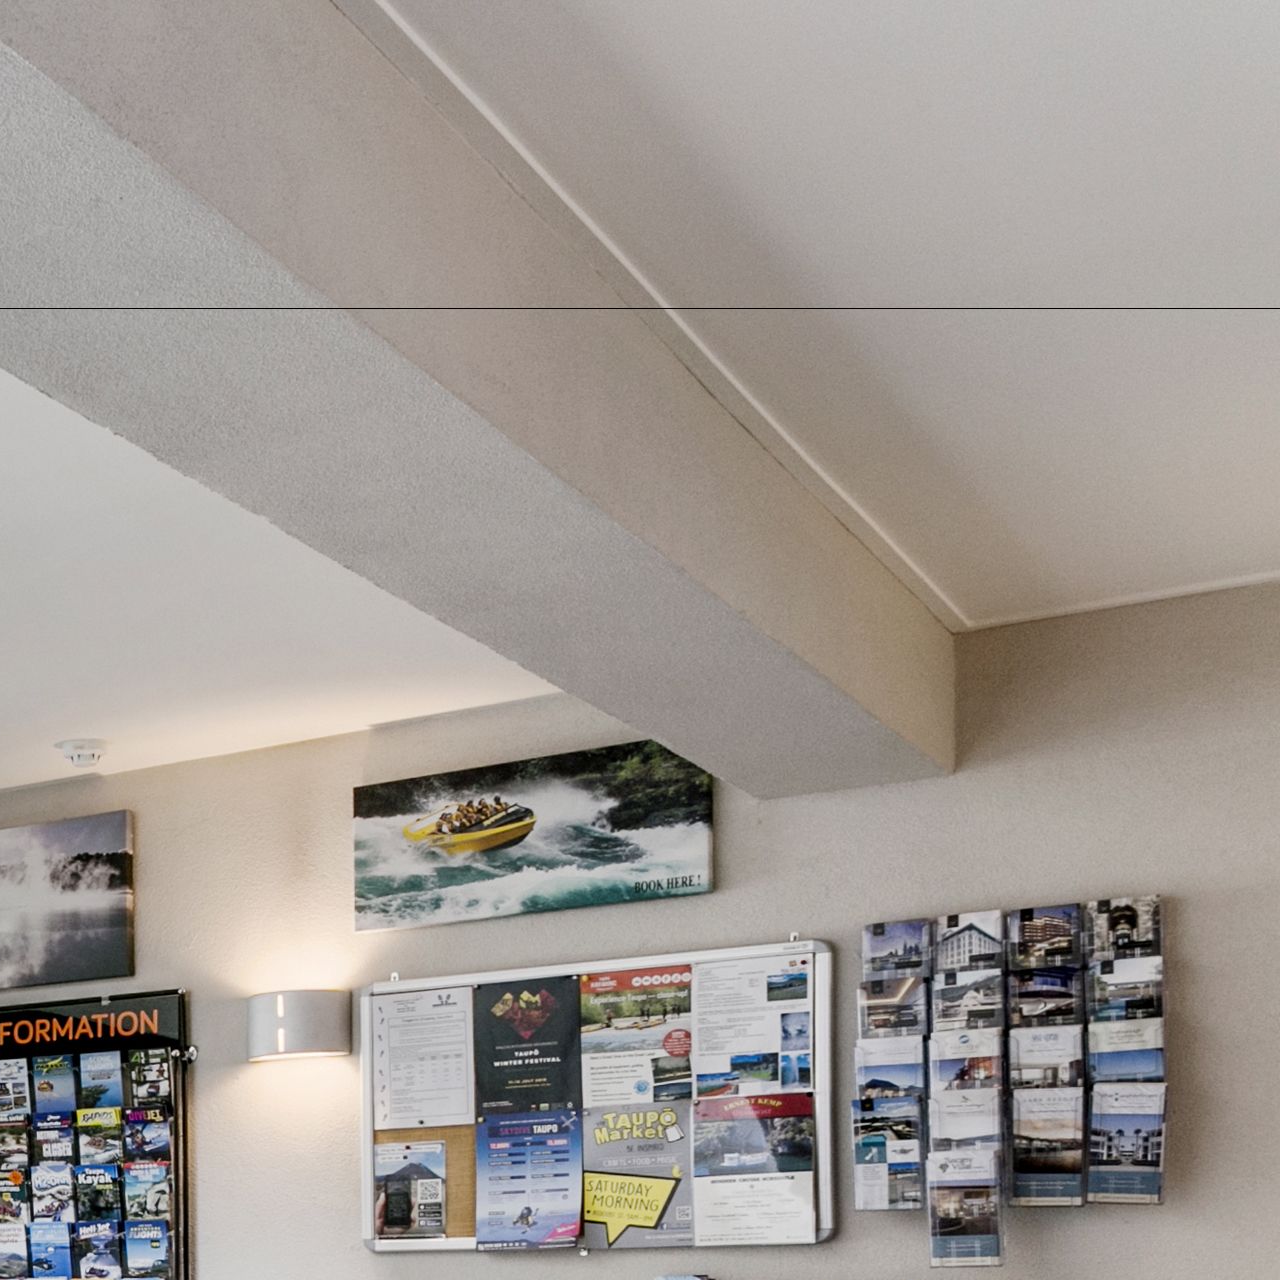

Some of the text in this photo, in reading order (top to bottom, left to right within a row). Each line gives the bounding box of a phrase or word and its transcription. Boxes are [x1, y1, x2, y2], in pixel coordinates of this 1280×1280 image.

[634, 879, 665, 893] BOOK
[666, 875, 695, 889] HERE
[524, 1057, 561, 1065] FESTIVAL
[757, 1098, 783, 1108] KEMP
[532, 1124, 558, 1134] TAUPO
[594, 1125, 665, 1145] Market
[78, 1174, 113, 1186] Kayak
[586, 1180, 653, 1197] SATURDAY
[592, 1195, 660, 1212] MORNING
